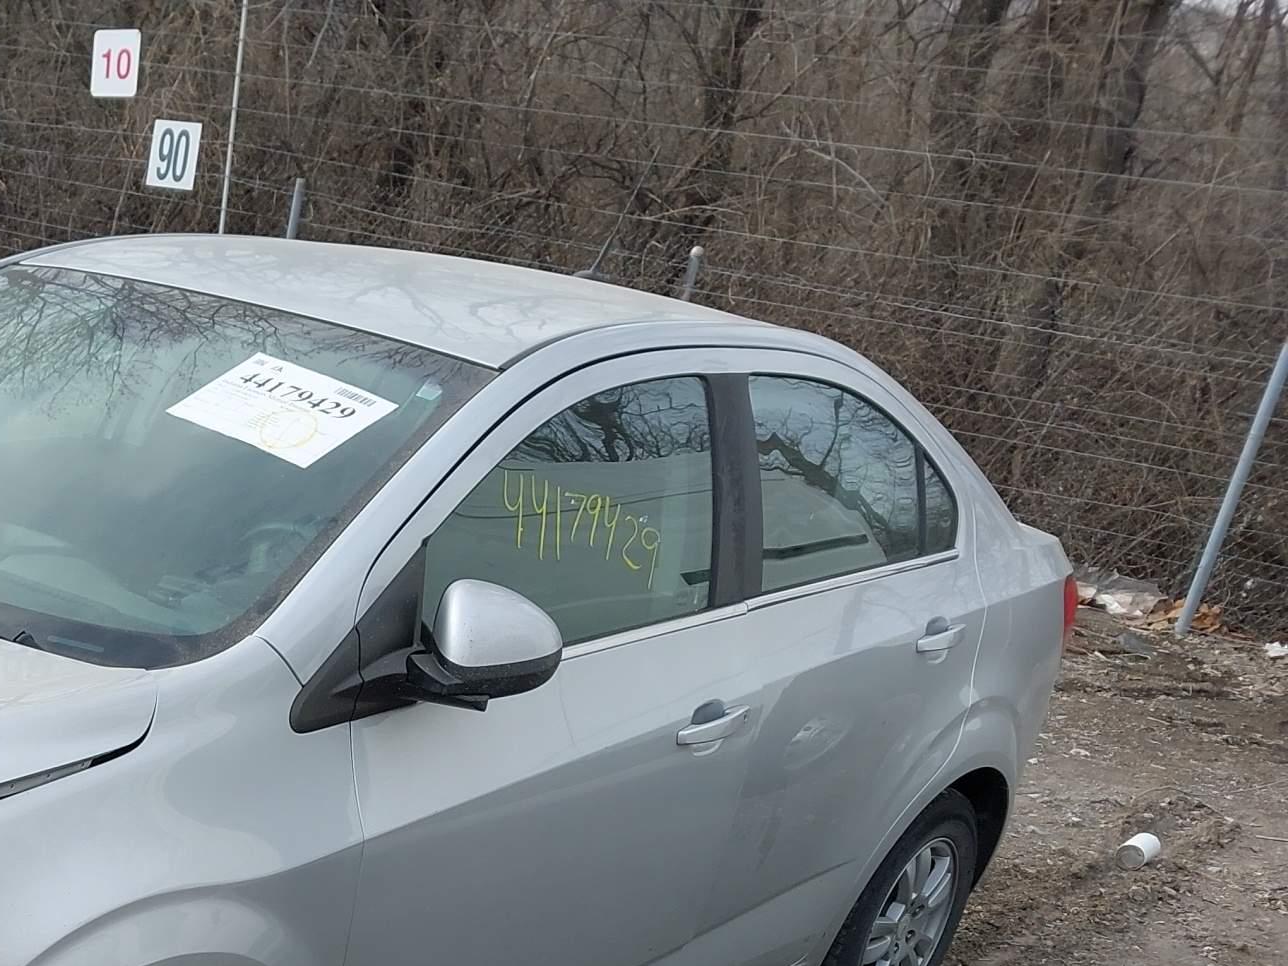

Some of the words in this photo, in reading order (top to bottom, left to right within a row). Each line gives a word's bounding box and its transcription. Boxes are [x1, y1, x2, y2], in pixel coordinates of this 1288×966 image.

[102, 48, 131, 79] 10
[157, 127, 190, 182] 90
[240, 373, 357, 419] 44179429
[504, 469, 661, 590] 44179429
